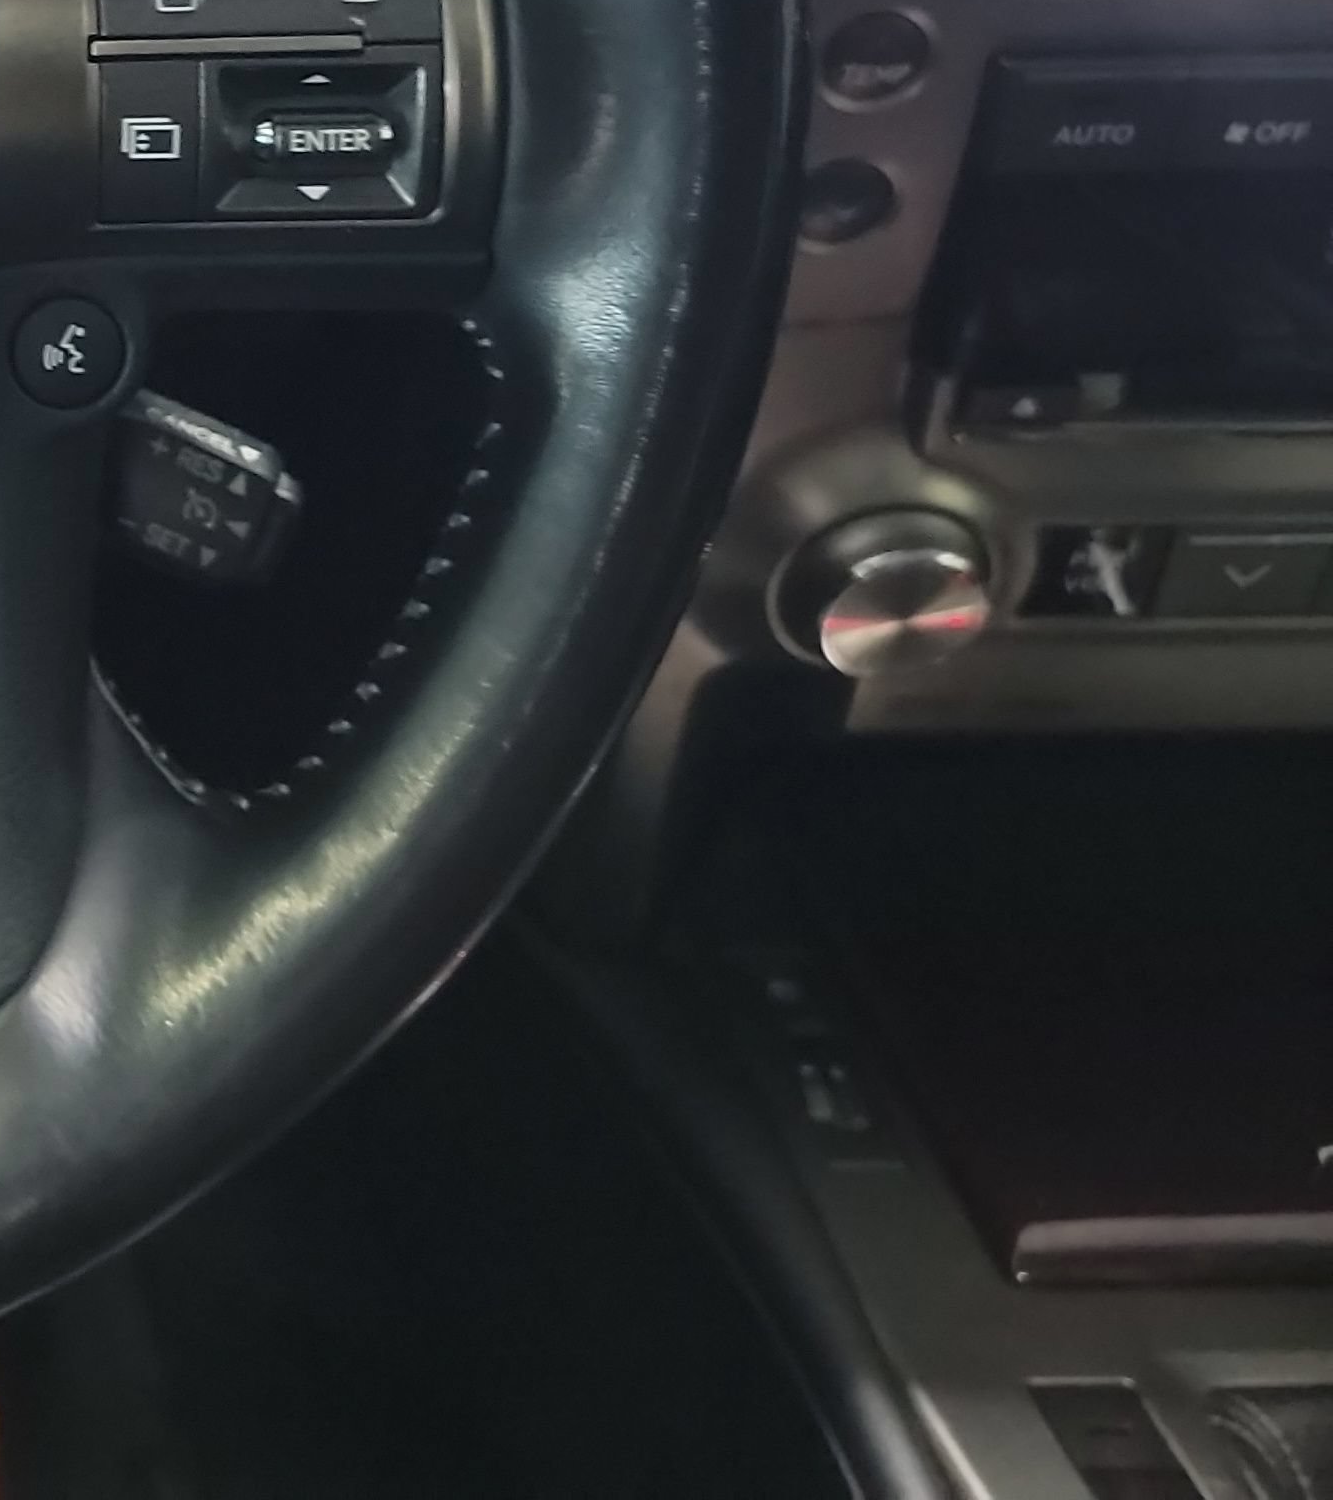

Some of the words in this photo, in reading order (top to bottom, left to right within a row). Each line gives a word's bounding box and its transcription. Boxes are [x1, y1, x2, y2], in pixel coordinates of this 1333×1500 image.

[288, 128, 373, 153] ENTER
[1052, 122, 1136, 146] AUTO
[1253, 120, 1313, 146] OFF
